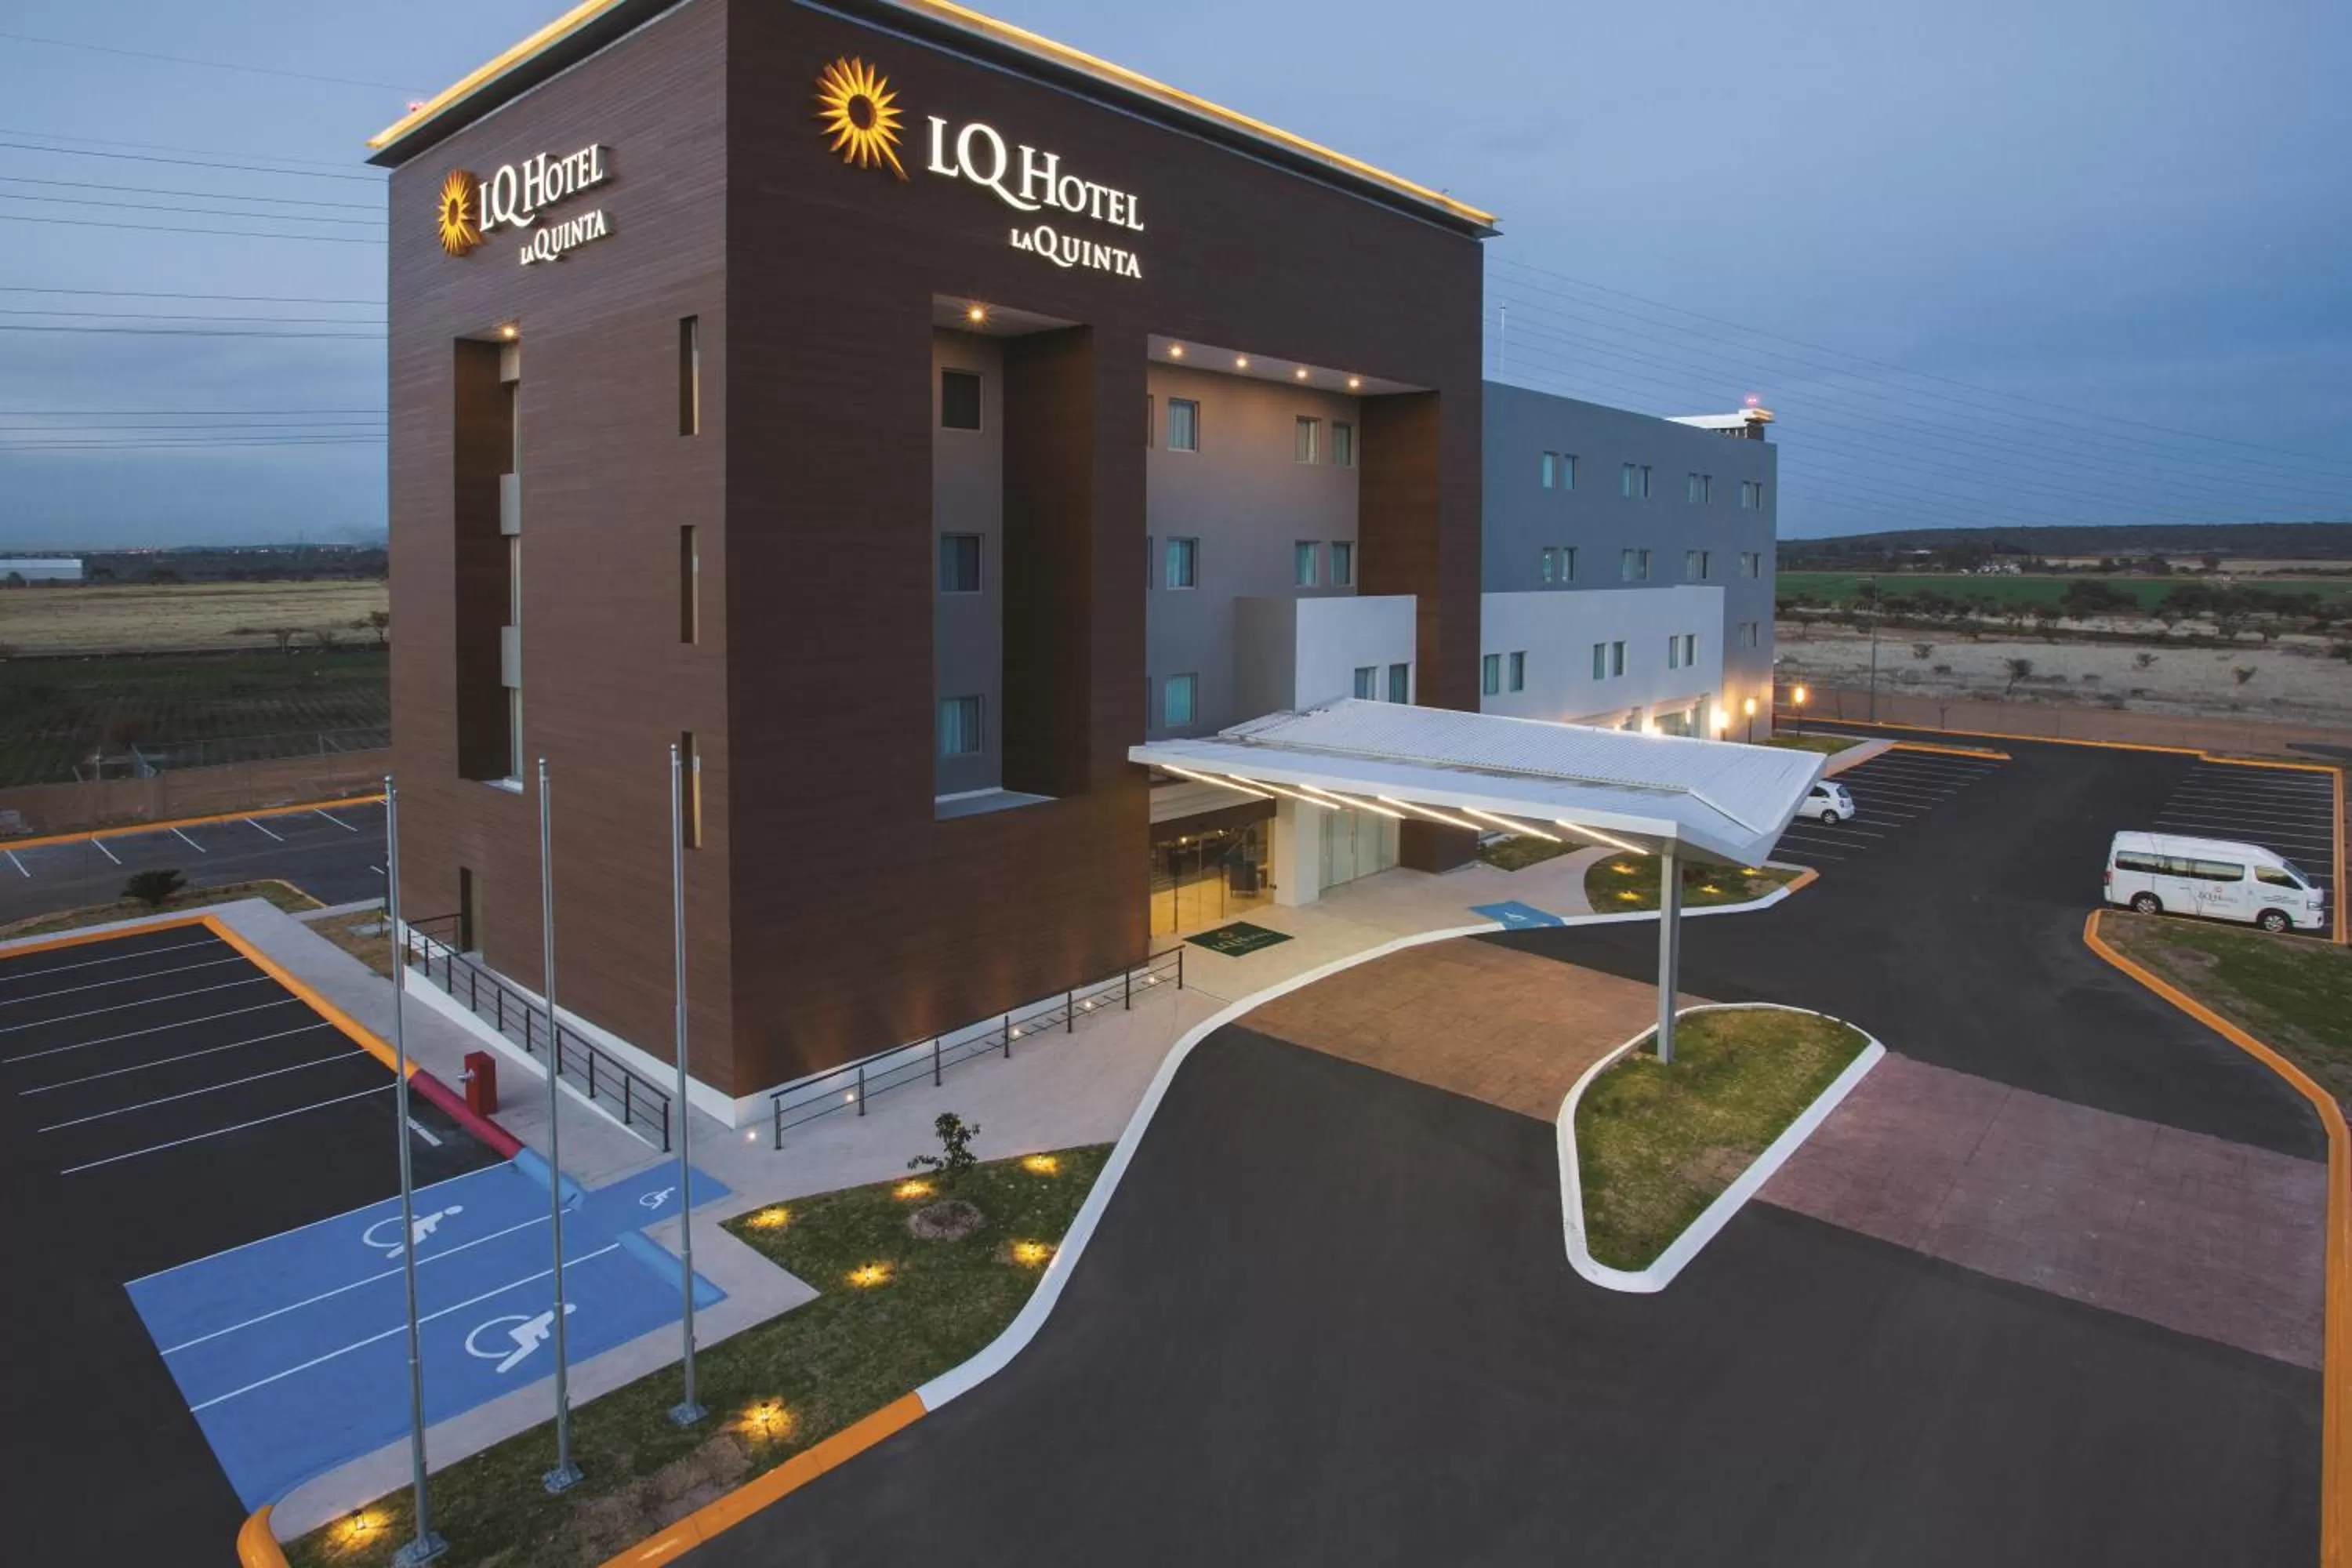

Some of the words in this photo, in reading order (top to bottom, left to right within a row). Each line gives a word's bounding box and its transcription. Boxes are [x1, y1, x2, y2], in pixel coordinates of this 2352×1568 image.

[479, 164, 535, 232] LQ
[522, 143, 604, 213] HOTEL
[927, 115, 1042, 211] LQ
[1018, 145, 1145, 231] HOTEL
